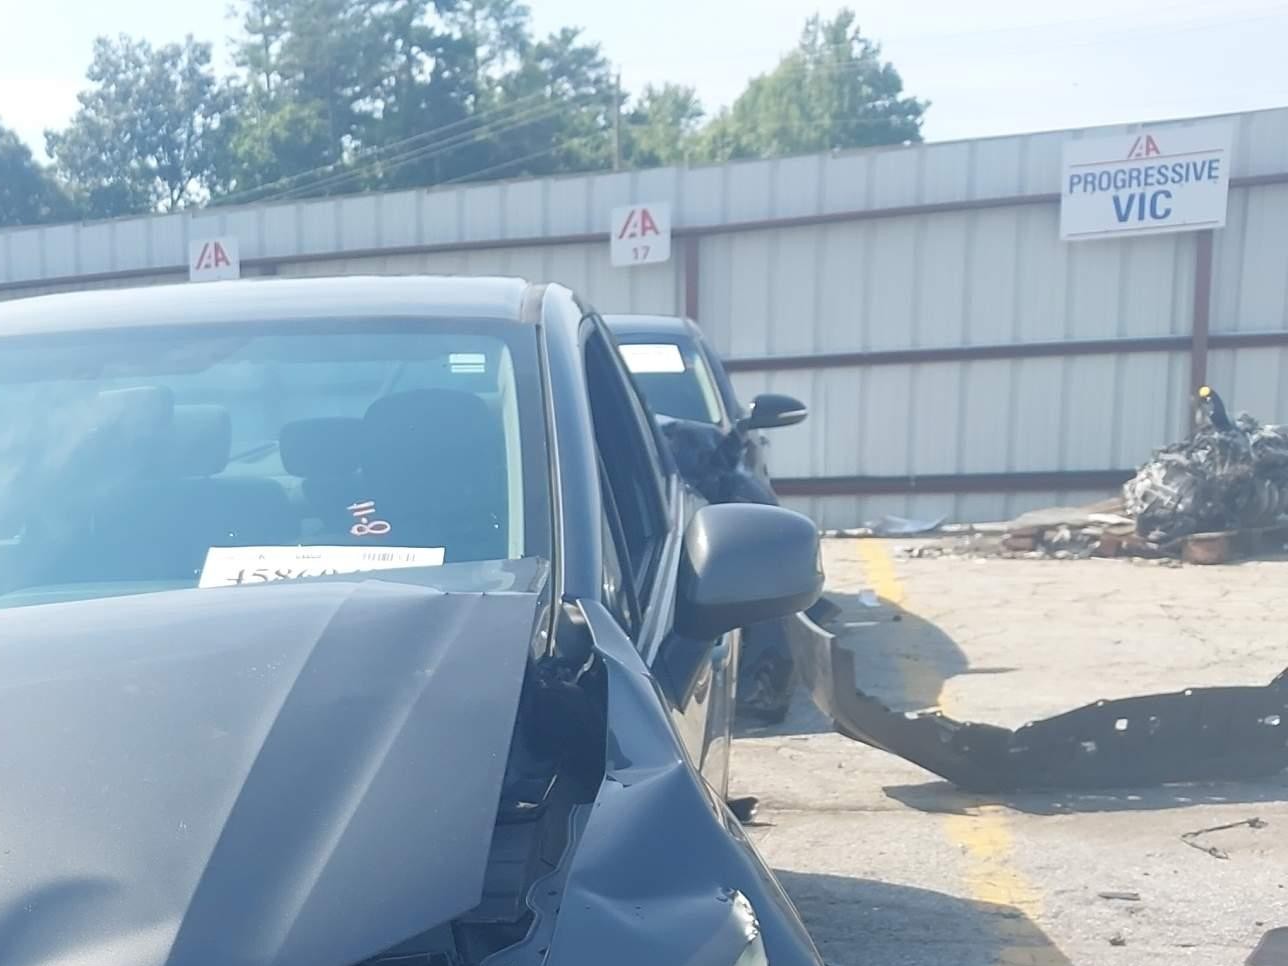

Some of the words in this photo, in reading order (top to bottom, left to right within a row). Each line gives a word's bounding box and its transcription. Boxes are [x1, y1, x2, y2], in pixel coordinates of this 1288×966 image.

[1068, 159, 1221, 195] PROGRESSIVE
[1112, 189, 1173, 223] VIC
[632, 245, 650, 260] 17
